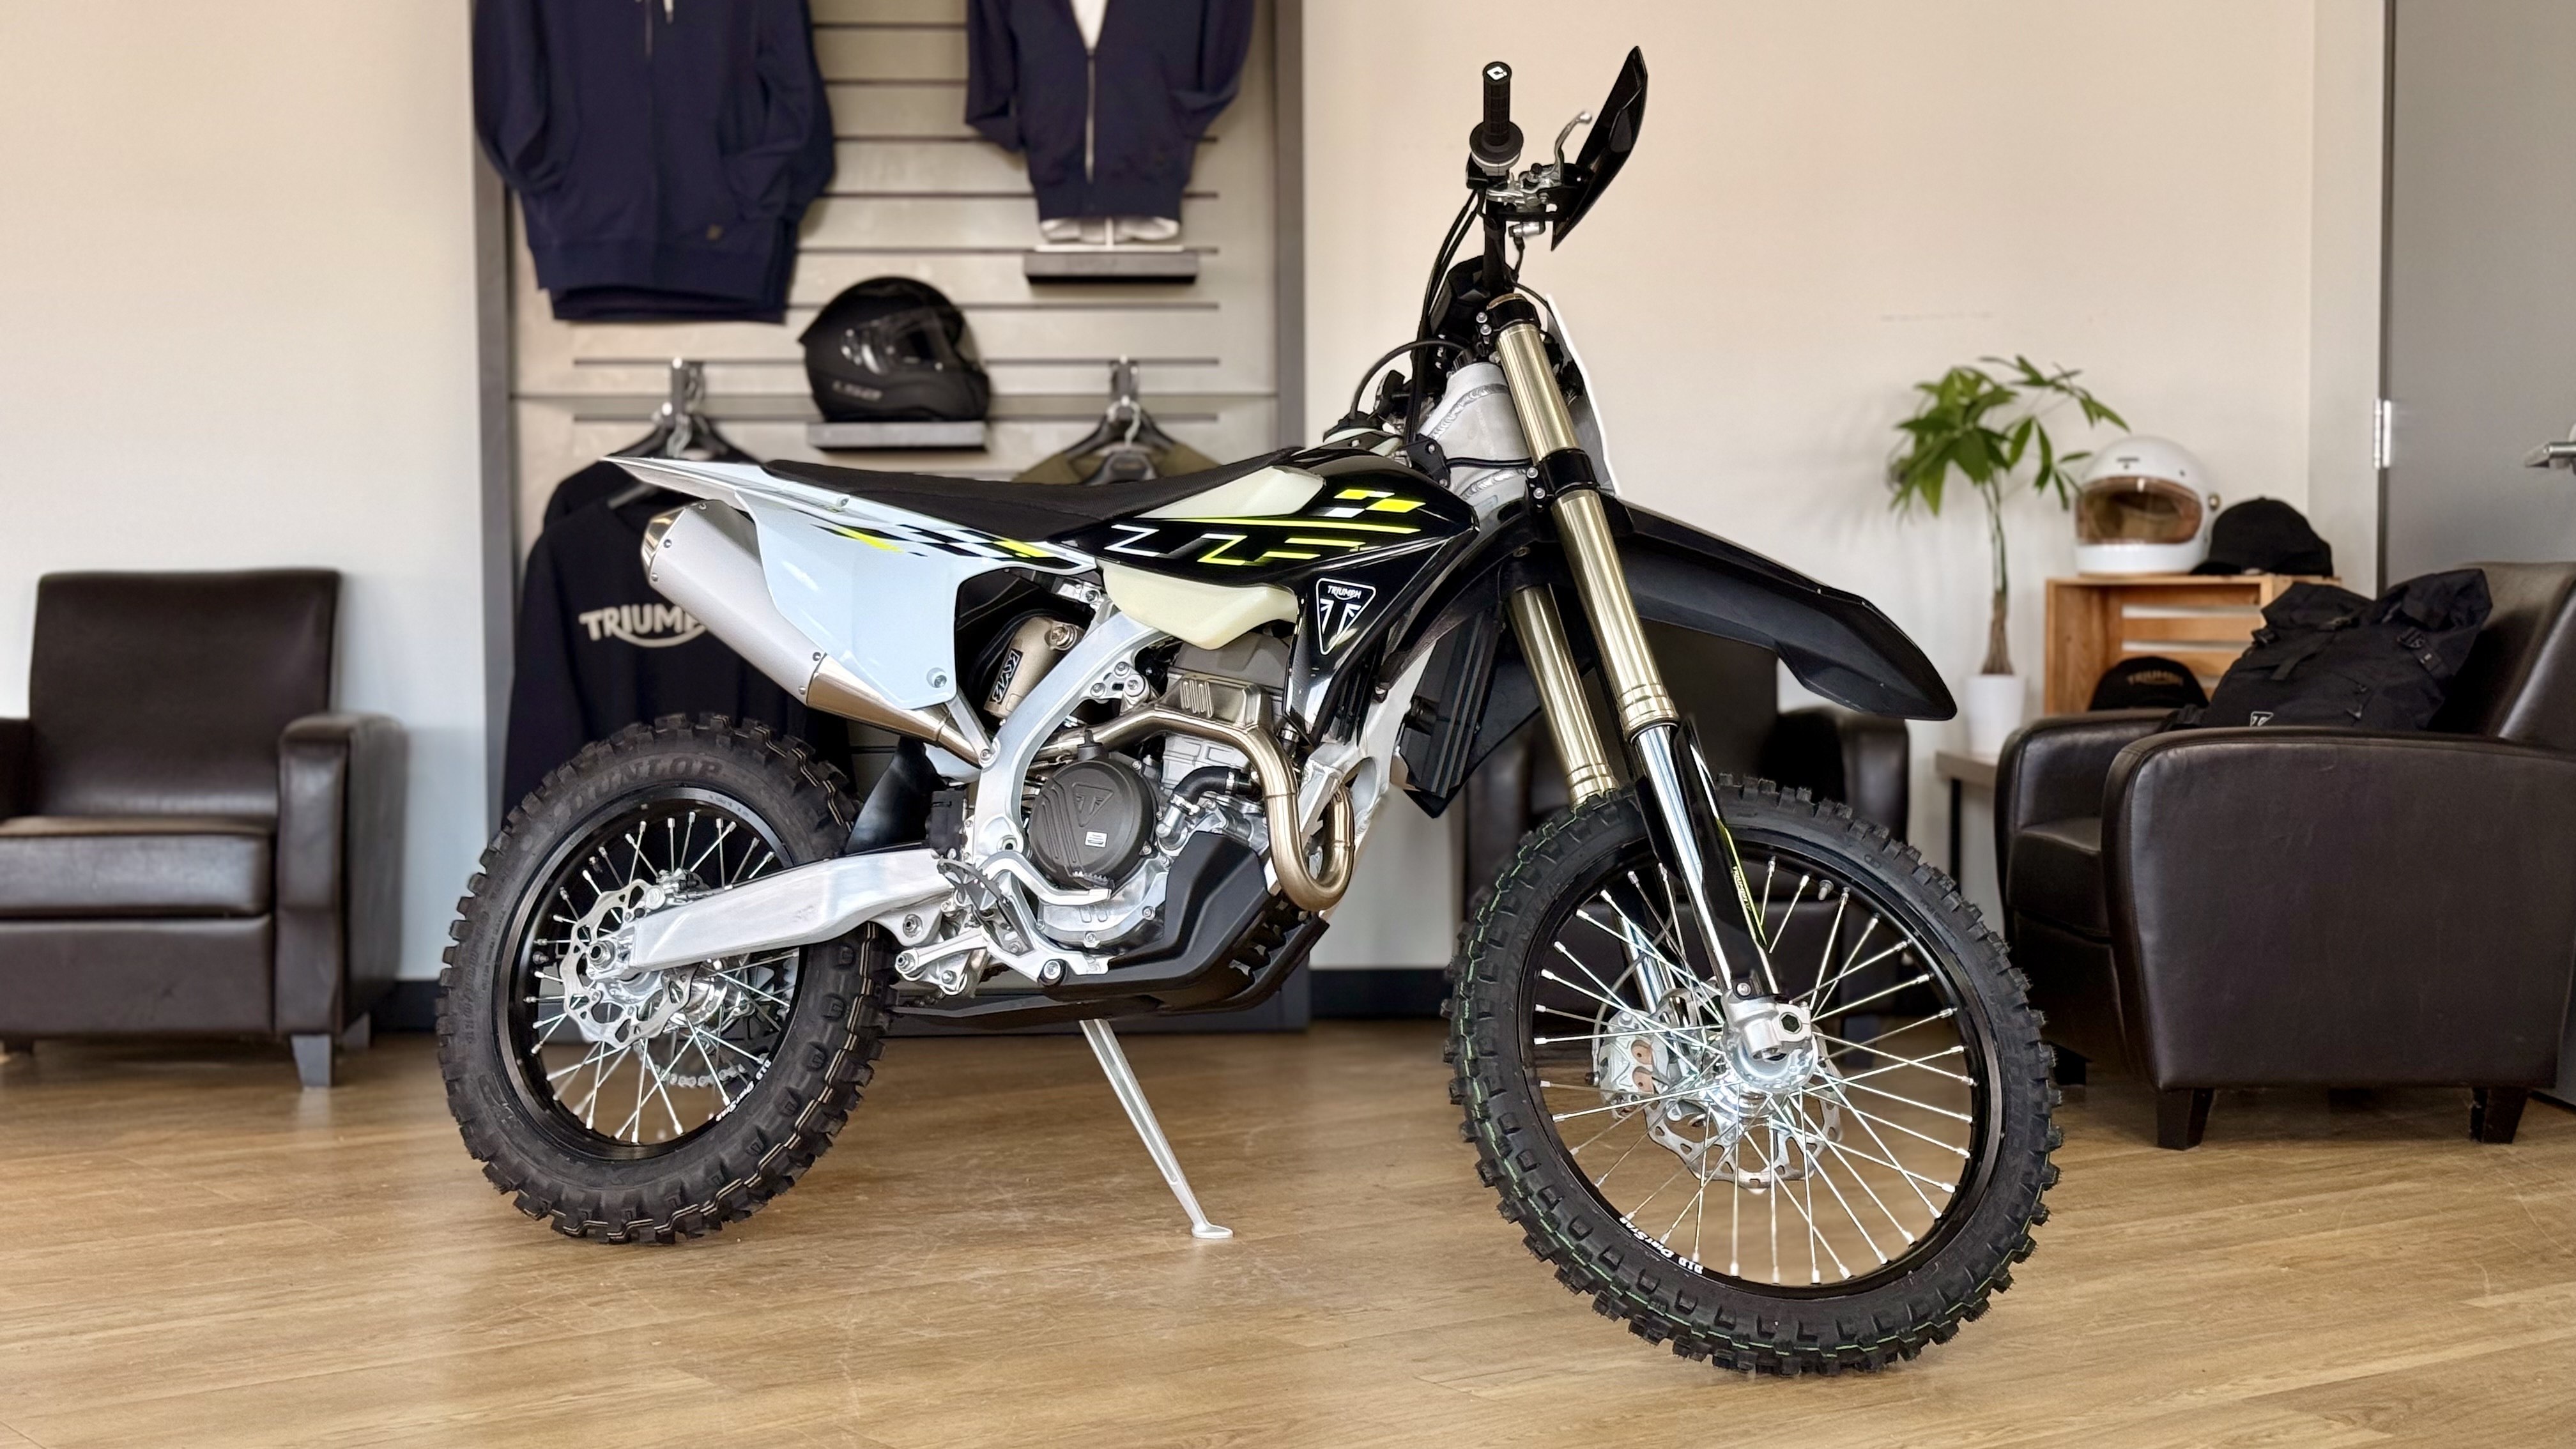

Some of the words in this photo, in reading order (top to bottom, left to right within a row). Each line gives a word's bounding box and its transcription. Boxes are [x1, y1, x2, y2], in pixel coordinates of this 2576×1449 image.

[1328, 585, 1362, 600] TRIUMPH
[579, 604, 706, 648] TRIUM
[992, 650, 1020, 703] KYB
[566, 755, 723, 815] DUNLOP
[1678, 1257, 1704, 1275] DID
